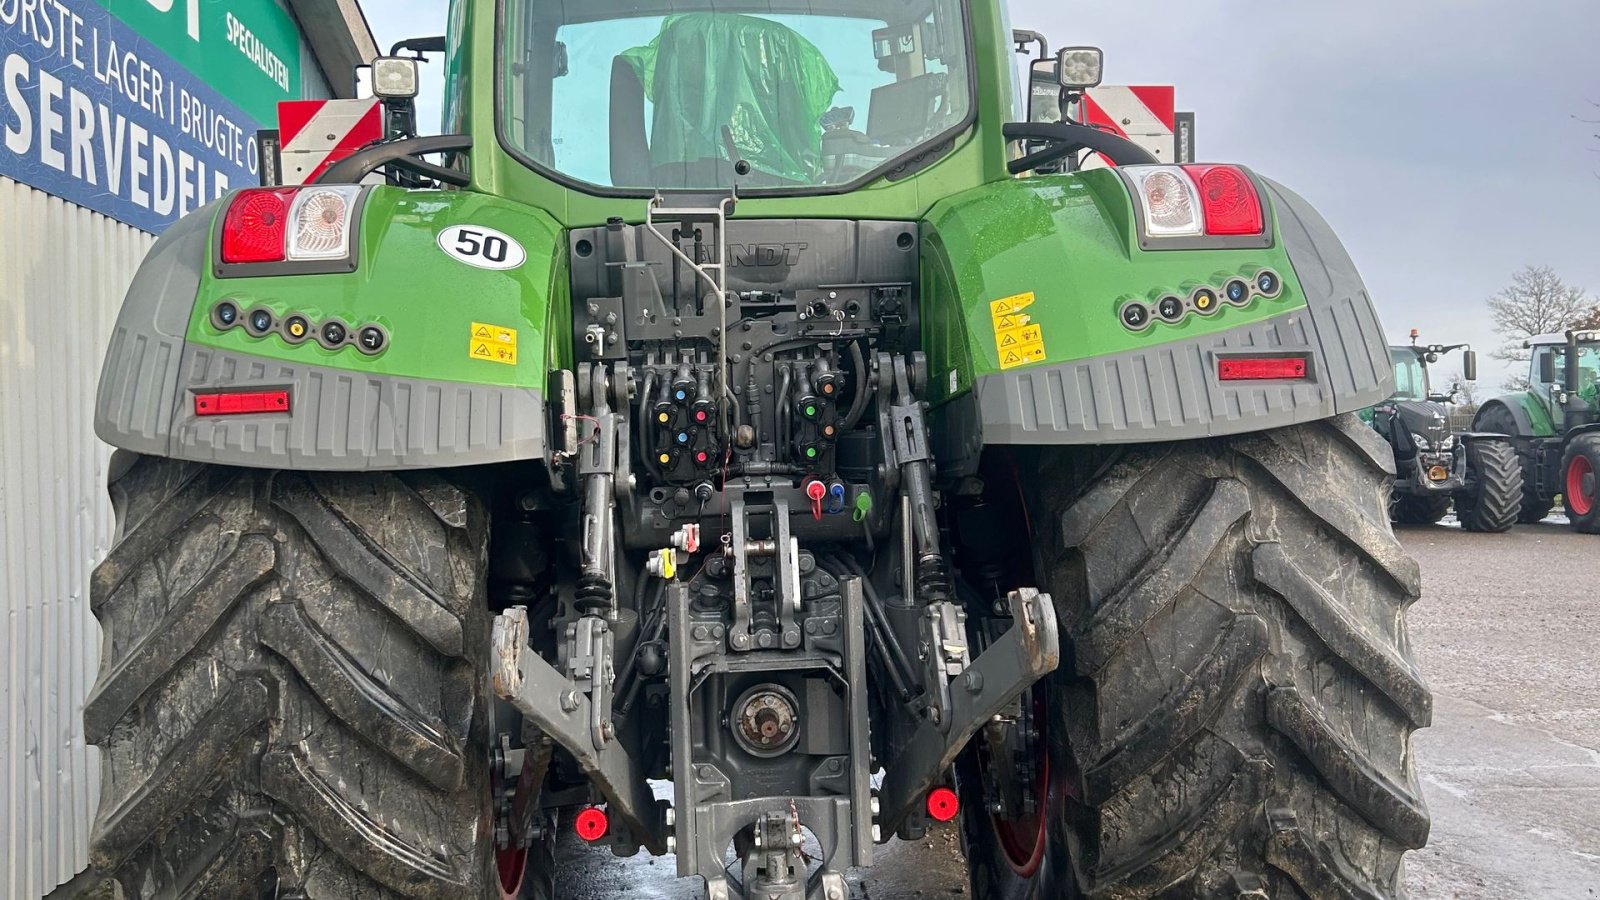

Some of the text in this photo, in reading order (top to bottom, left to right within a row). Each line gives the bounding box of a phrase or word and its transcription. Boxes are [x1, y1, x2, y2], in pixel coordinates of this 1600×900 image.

[227, 11, 289, 93] SPECIALISTEN
[94, 27, 164, 119] LAGER
[181, 88, 243, 168] BRUGTE
[455, 229, 509, 263] 50
